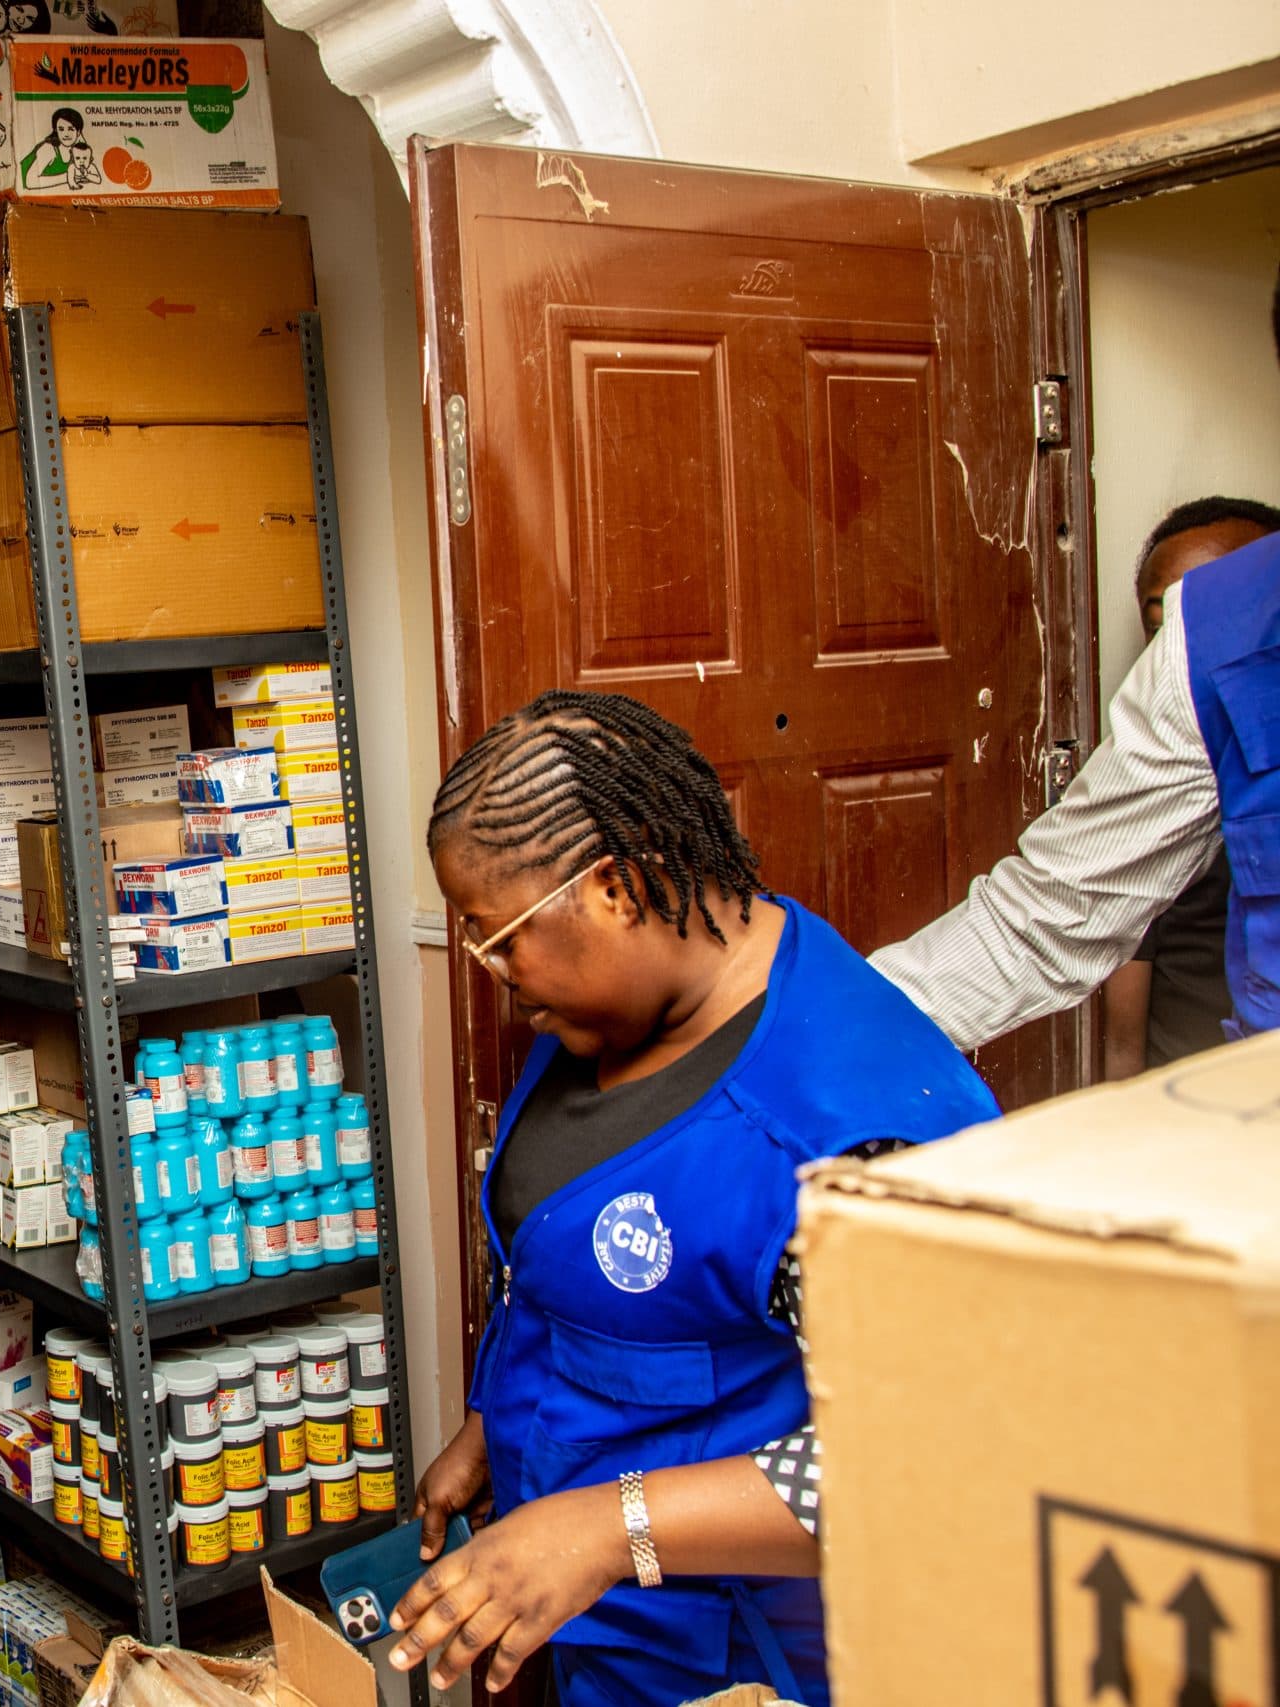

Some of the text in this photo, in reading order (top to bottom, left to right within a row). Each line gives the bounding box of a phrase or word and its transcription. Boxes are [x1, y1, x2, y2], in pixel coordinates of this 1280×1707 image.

[70, 46, 180, 56] WHO Recommended Formula
[61, 58, 189, 91] MarleyORS
[85, 106, 182, 115] ORAL REHYDRATION SALTS BP
[71, 195, 214, 206] ORAL REHYDRATION SALTS BP
[226, 666, 253, 680] Tanzol
[245, 716, 270, 729] Tanzol
[191, 815, 222, 826] BEXWORM
[179, 866, 211, 877] BEXWORM
[244, 868, 285, 884] Tanzol
[122, 872, 156, 884] BEXWORM
[182, 921, 215, 933] BEXWORM
[249, 920, 290, 936] Tanzol
[596, 1195, 646, 1271] CARE BEST
[611, 1220, 659, 1263] CBI
[308, 1431, 336, 1441] Folic Acid
[226, 1456, 256, 1466] Folic Acid
[193, 1472, 207, 1481] Folic
[366, 1480, 380, 1488] Folic
[198, 1532, 212, 1541] Folic
